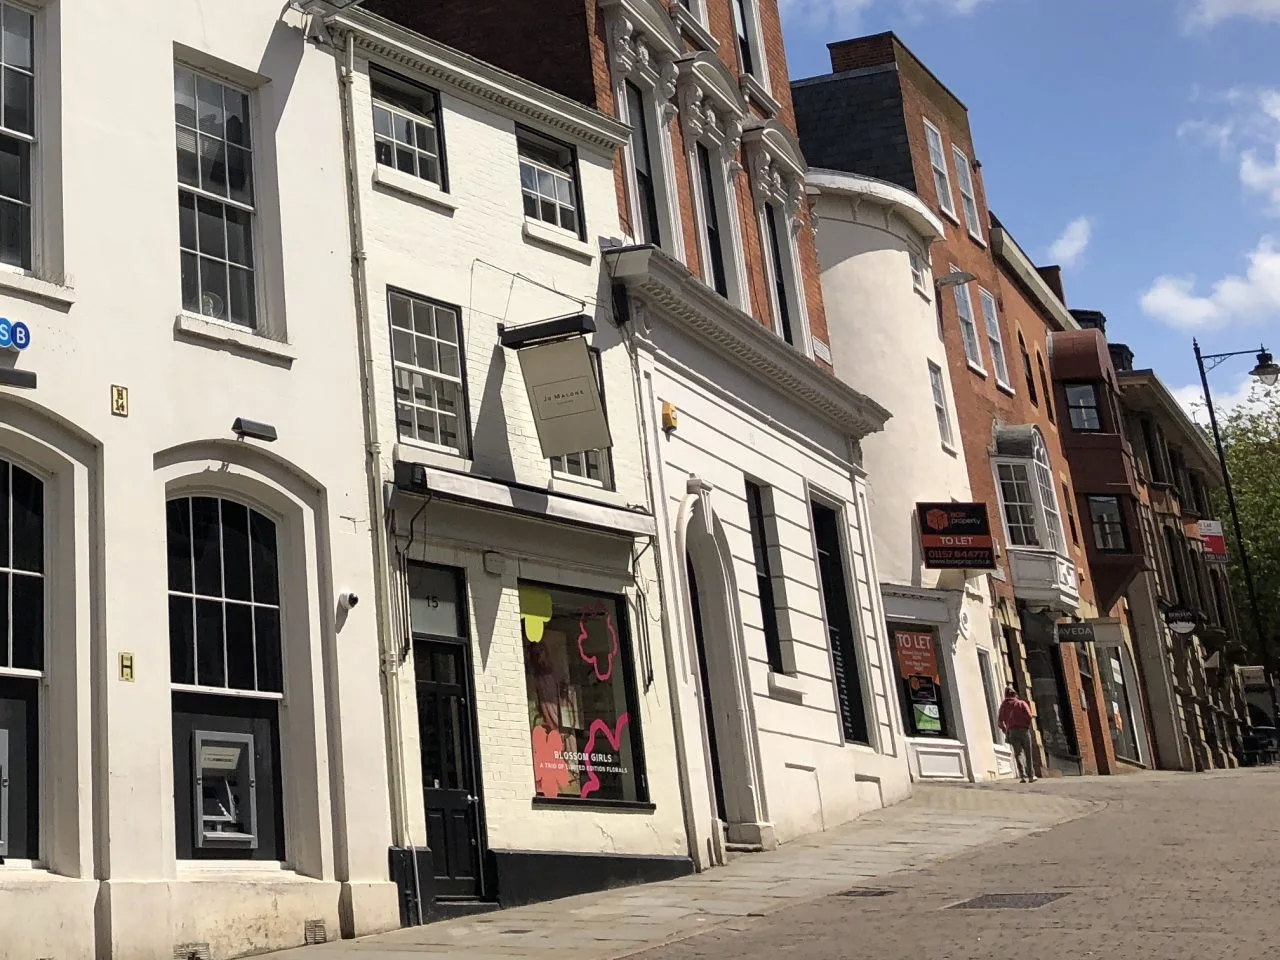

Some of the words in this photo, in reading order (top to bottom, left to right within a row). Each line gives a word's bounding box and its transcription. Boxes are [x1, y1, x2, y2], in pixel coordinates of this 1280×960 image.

[940, 536, 954, 545] TO
[955, 536, 973, 545] LET
[425, 595, 439, 609] 15
[1059, 627, 1093, 636] AVEDA
[896, 634, 911, 648] TO
[913, 635, 931, 650] LET
[121, 654, 133, 680] H
[554, 751, 589, 761] BLOSSOM
[590, 753, 612, 763] GIRLS
